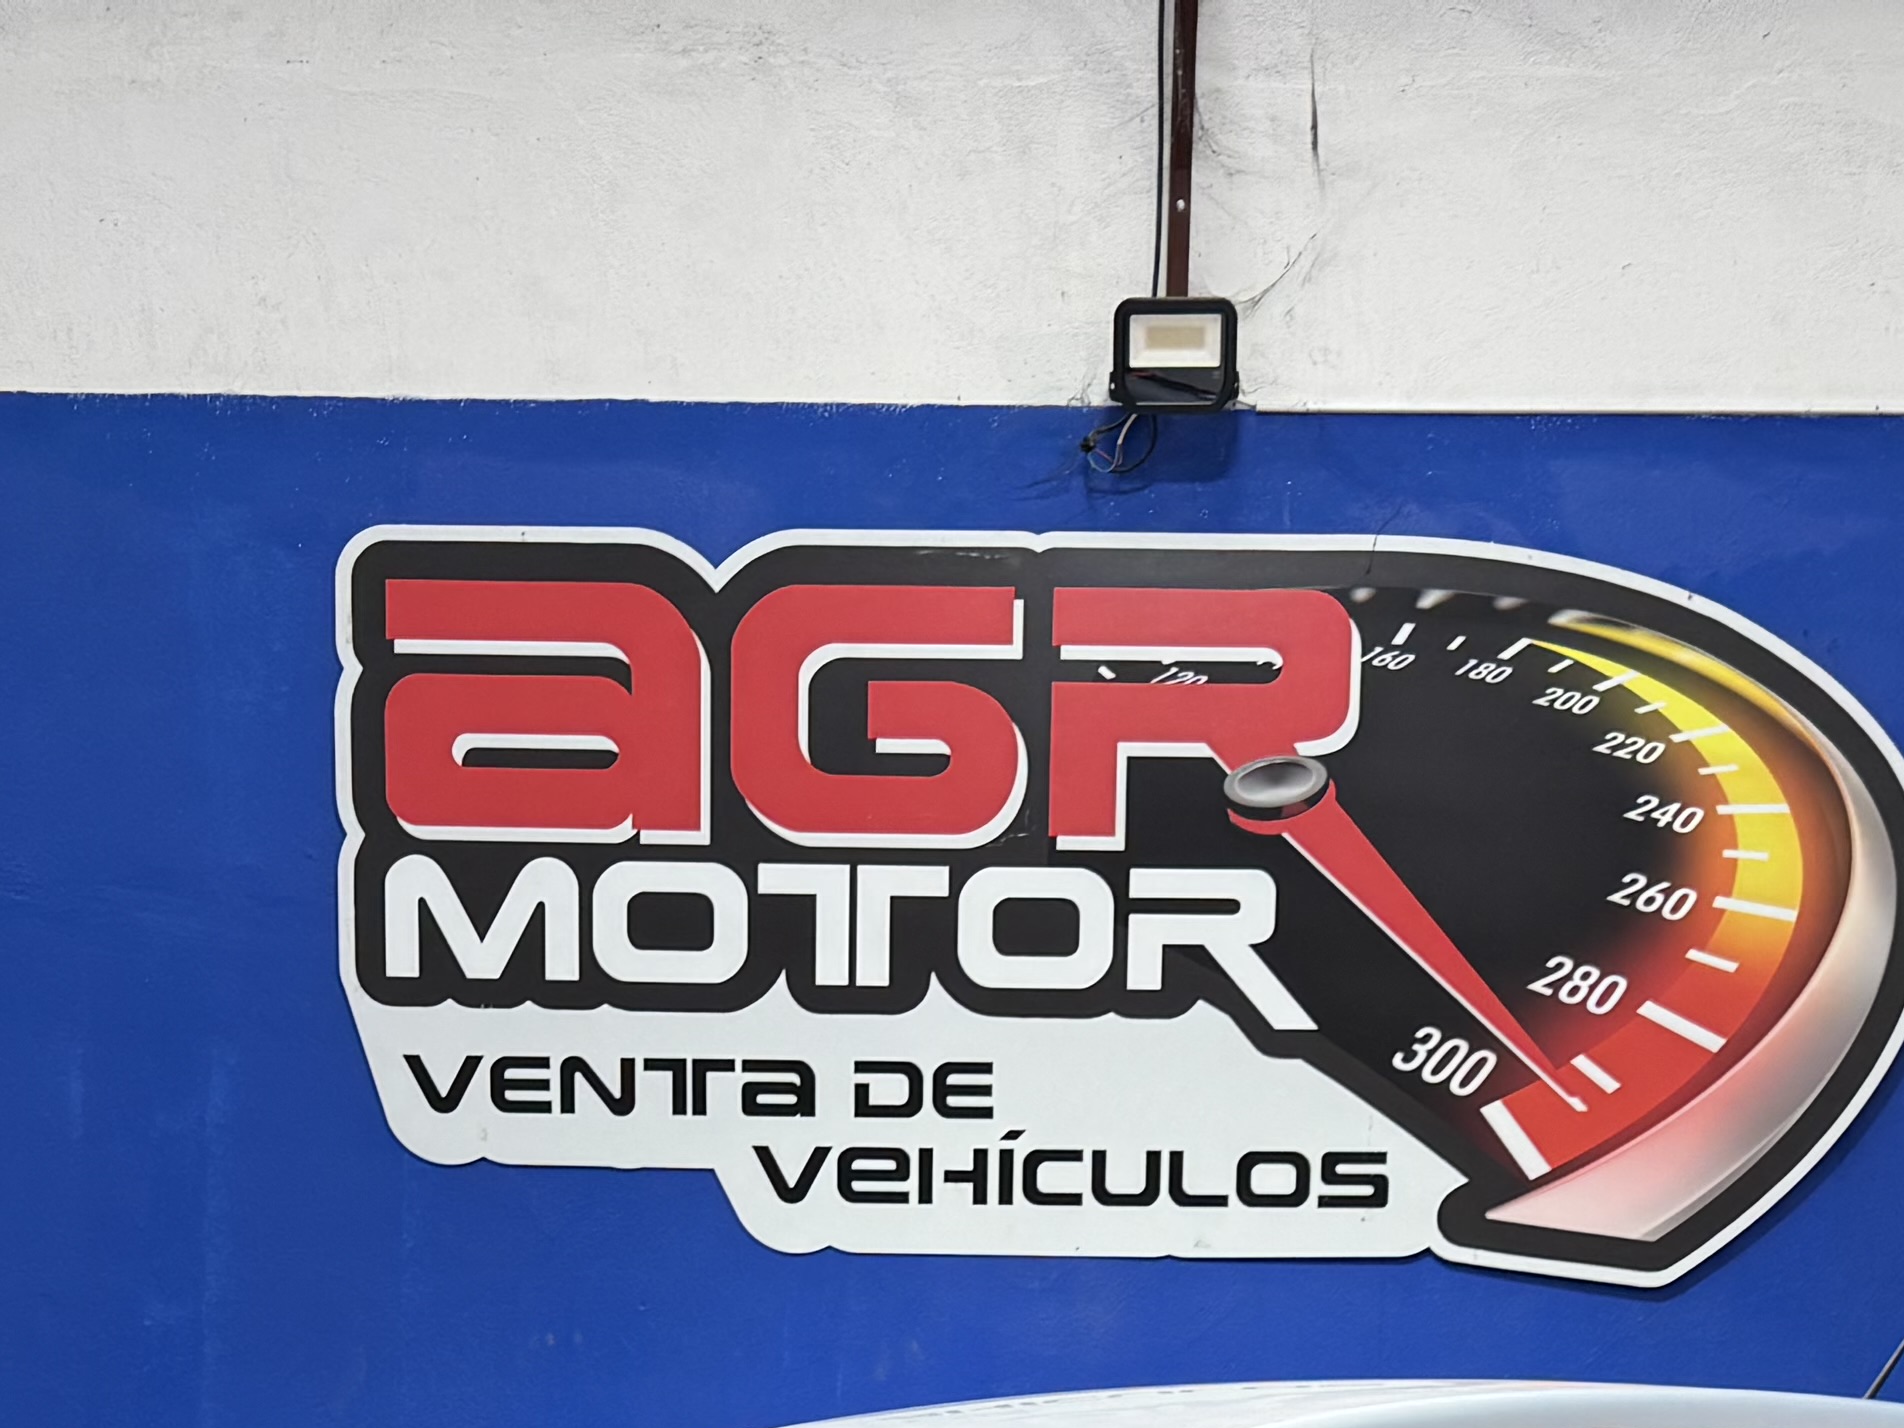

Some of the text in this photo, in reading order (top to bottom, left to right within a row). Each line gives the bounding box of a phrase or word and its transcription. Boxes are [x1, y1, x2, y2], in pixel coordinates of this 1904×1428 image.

[1360, 646, 1416, 671] 160
[1455, 654, 1514, 686] 180
[1532, 686, 1601, 717] 200
[1592, 730, 1666, 766] 220
[1622, 793, 1705, 836] 240
[1605, 872, 1698, 922] 260
[384, 853, 1319, 1030] MOTOR
[1525, 954, 1629, 1017] 280
[1390, 1024, 1498, 1099] 300
[852, 1060, 995, 1121] DE
